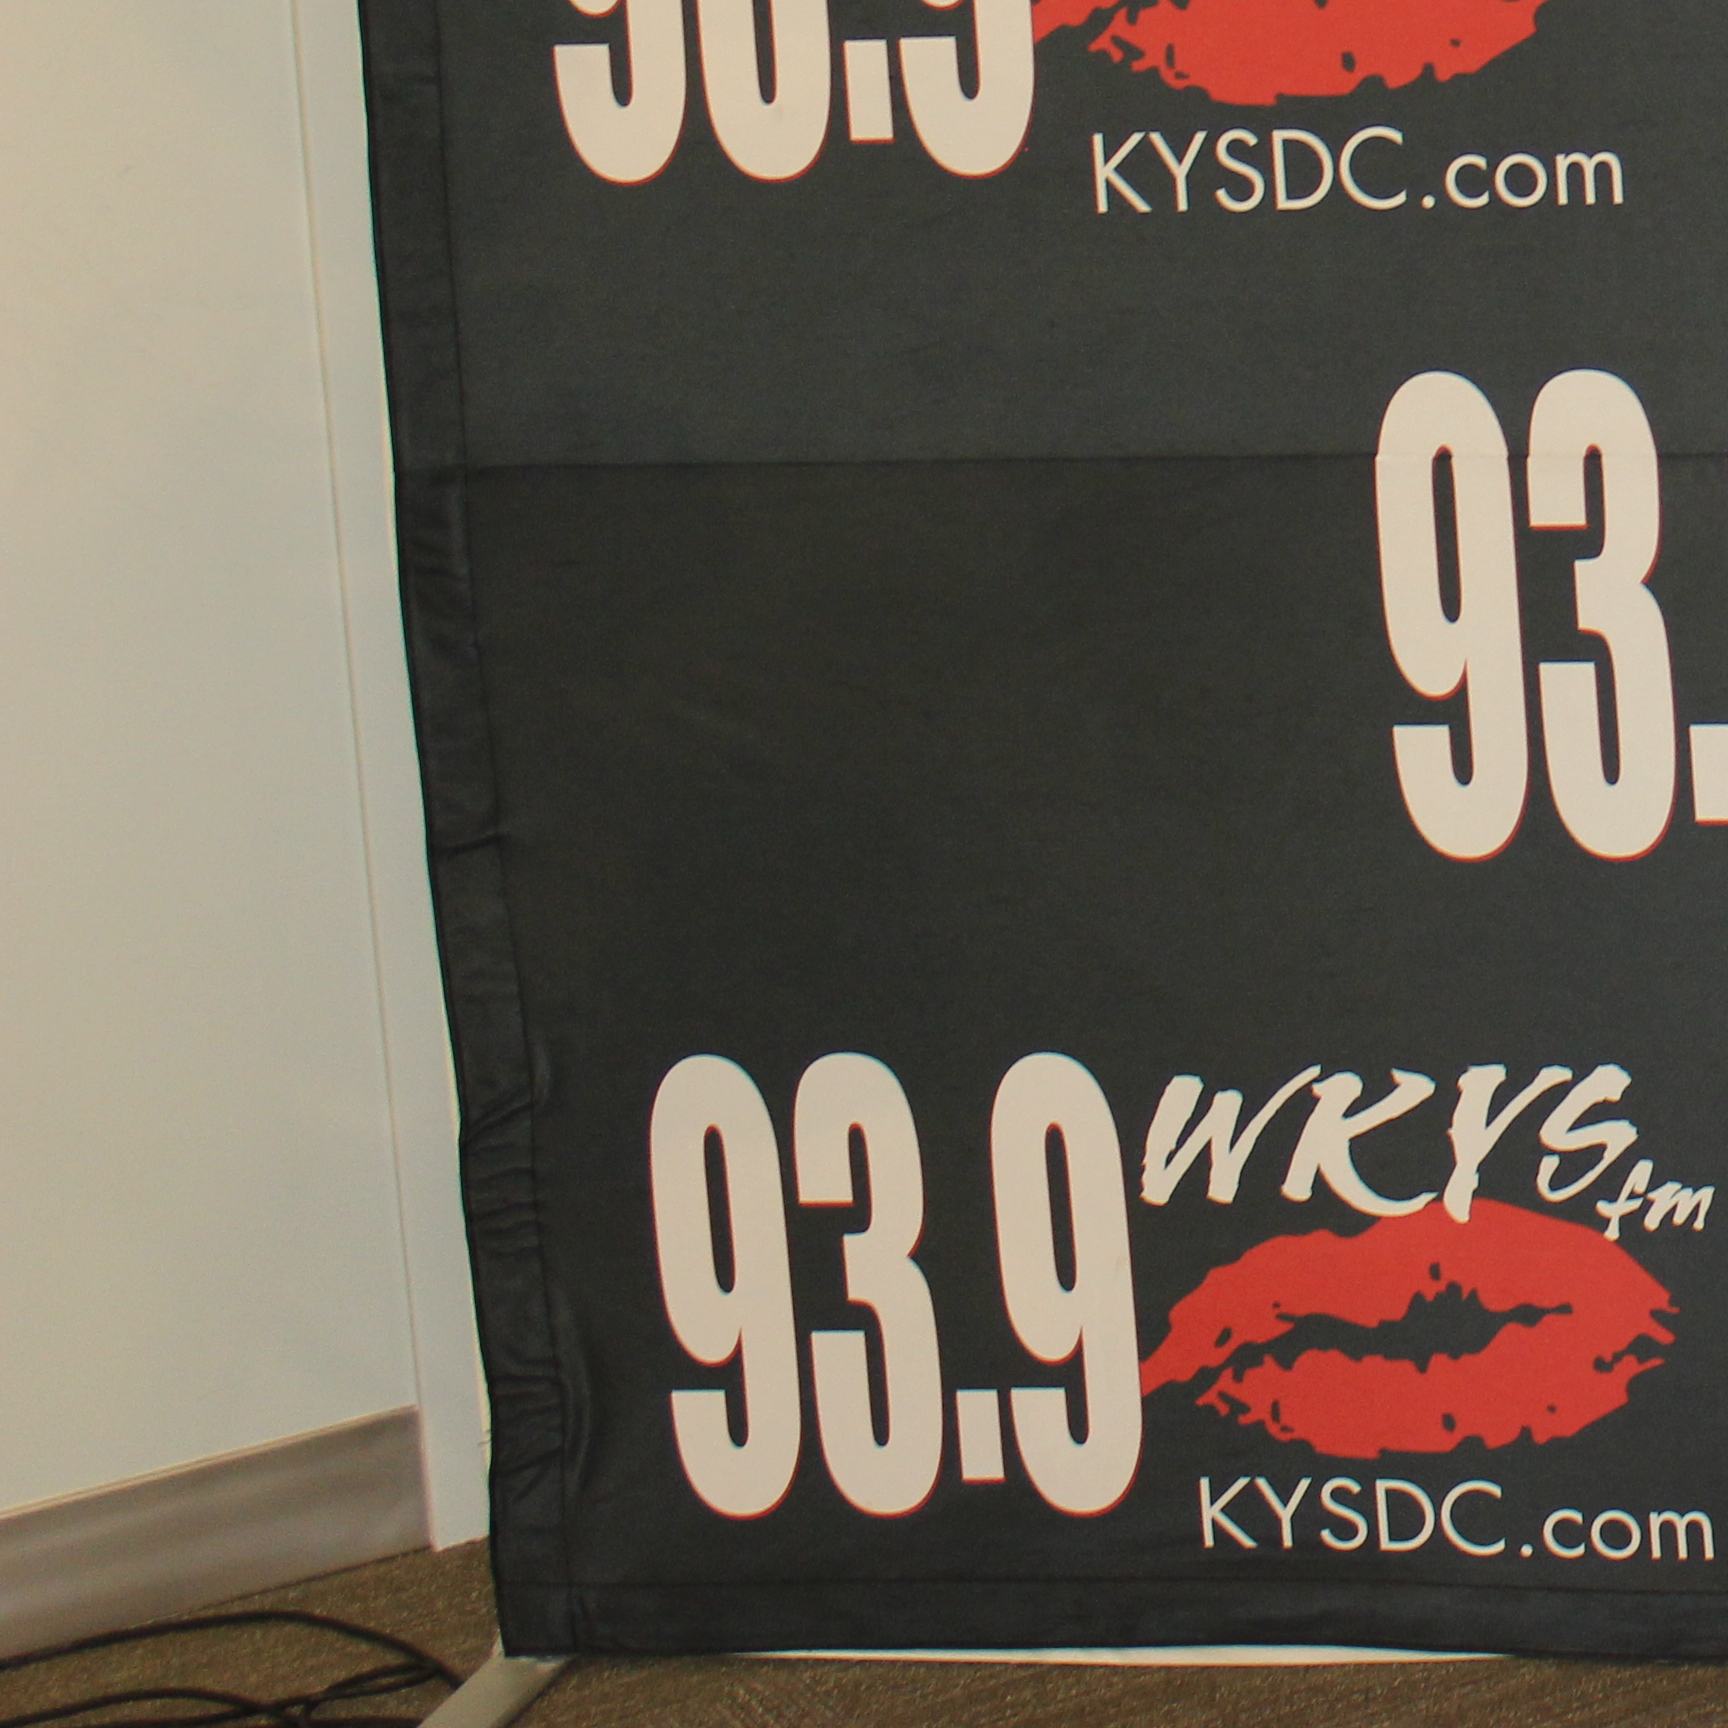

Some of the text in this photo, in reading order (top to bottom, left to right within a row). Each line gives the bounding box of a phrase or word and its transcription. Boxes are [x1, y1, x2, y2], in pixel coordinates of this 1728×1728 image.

[1093, 126, 1624, 213] KYSDC.com
[649, 1051, 1716, 1517] 93.9 WKYS fm
[1200, 1476, 1714, 1558] KYSDC.com
